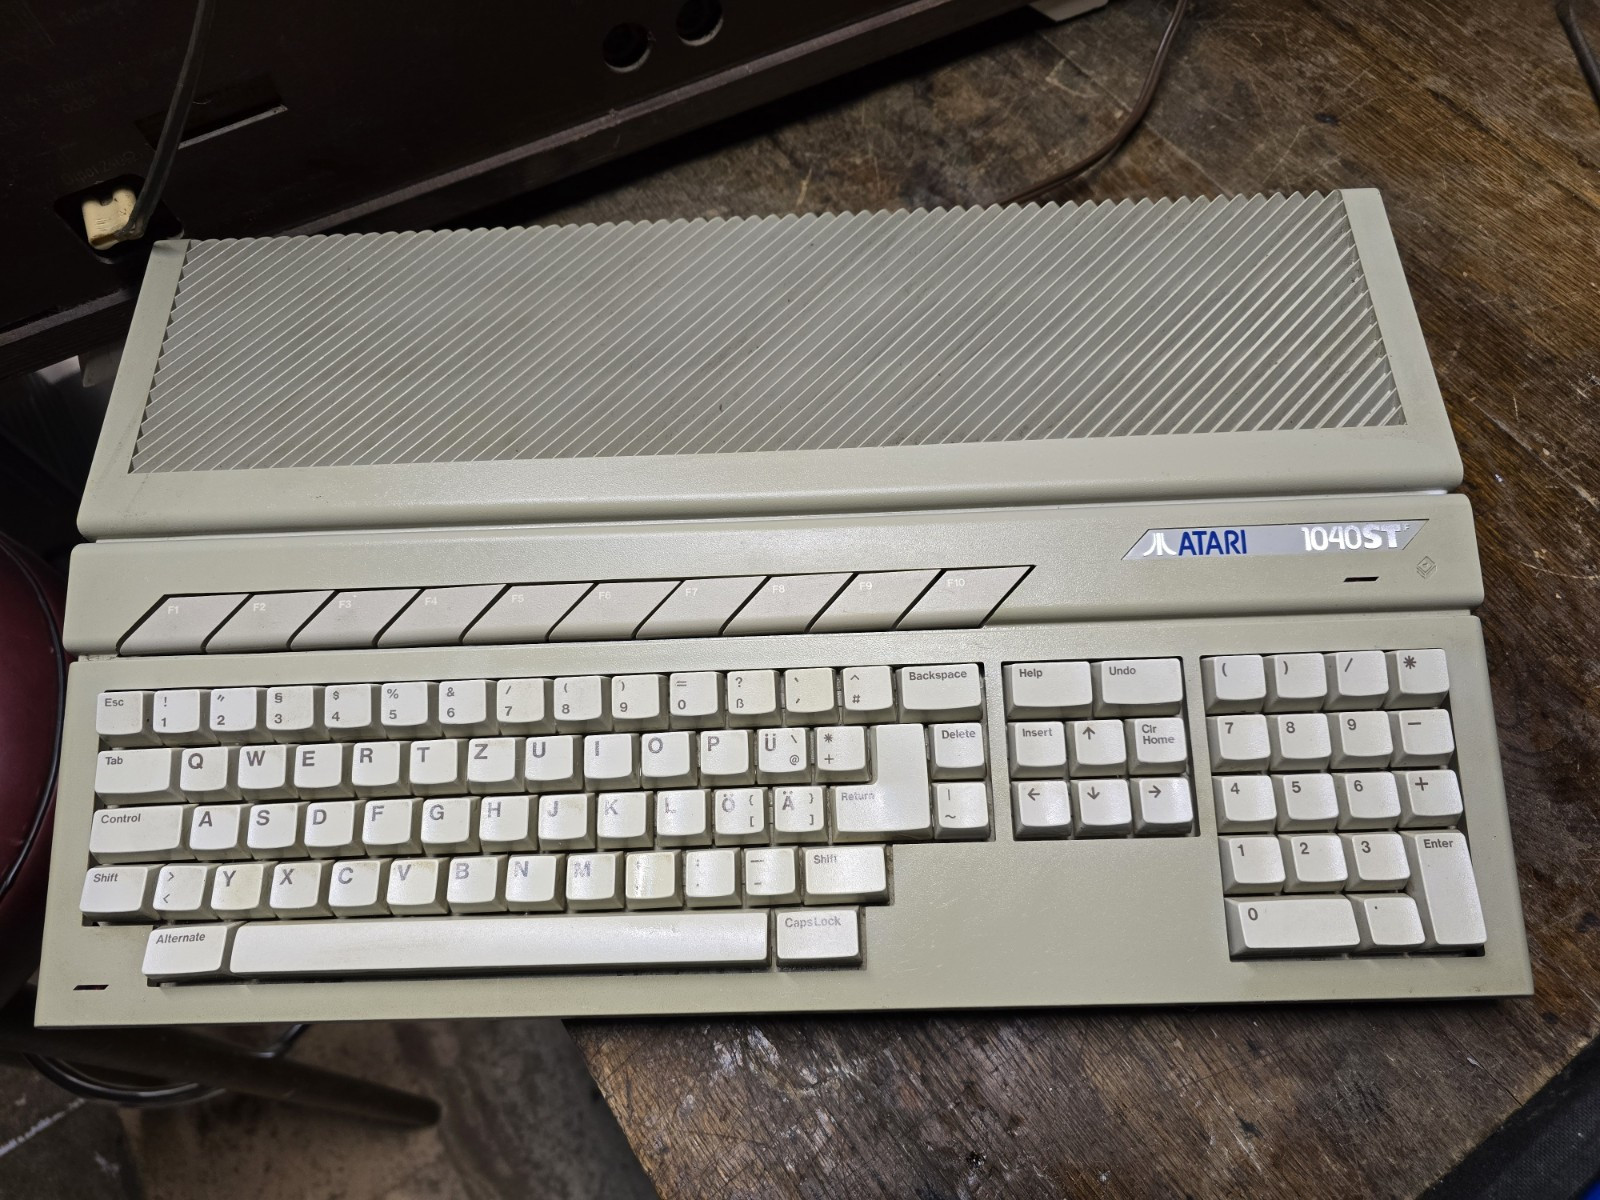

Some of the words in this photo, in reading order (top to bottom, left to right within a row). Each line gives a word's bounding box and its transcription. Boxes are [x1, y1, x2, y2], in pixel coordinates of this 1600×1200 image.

[1178, 529, 1247, 556] ATARI
[772, 584, 785, 594] F8
[859, 581, 872, 591] F9
[947, 578, 965, 588] F10
[511, 594, 525, 603] F5
[598, 591, 612, 600] F6
[685, 588, 698, 597] F7
[253, 602, 266, 612] F2
[338, 600, 352, 609] F3
[424, 597, 438, 606] F4
[167, 605, 179, 615] F1
[1344, 657, 1353, 672] /
[908, 670, 968, 682] Backspace
[1019, 668, 1043, 679] Help
[1109, 666, 1136, 676] Undo
[735, 676, 743, 688] ?
[274, 692, 283, 704] §
[332, 690, 340, 701] $
[386, 688, 399, 700] %
[446, 687, 455, 697] &
[104, 697, 124, 708] Esc
[851, 694, 861, 704] #
[447, 707, 456, 718] 6
[504, 705, 513, 717] 7
[561, 703, 570, 715] 8
[619, 702, 628, 713] 9
[217, 714, 226, 726] 2
[274, 713, 283, 724] 3
[331, 711, 341, 722] 4
[388, 709, 398, 720] 5
[161, 717, 167, 728] 1
[1224, 722, 1234, 734] 7
[1285, 721, 1296, 734] 8
[1346, 718, 1357, 731] 9
[941, 729, 976, 740] Delete
[1022, 727, 1053, 738] Insert
[647, 737, 664, 754] O
[707, 736, 720, 752] P
[764, 733, 777, 751] Ü
[1142, 735, 1175, 745] Home
[359, 747, 374, 764] R
[416, 746, 430, 763] T
[473, 743, 489, 760] Z
[532, 741, 546, 759] U
[105, 756, 124, 766] Tab
[187, 752, 204, 770] Q
[246, 750, 266, 767] W
[301, 750, 316, 767] E
[789, 754, 800, 766] @
[824, 754, 834, 765] +
[1230, 782, 1240, 795] 4
[1291, 781, 1301, 793] 5
[1353, 780, 1364, 792] 6
[1415, 777, 1429, 791] +
[782, 790, 795, 812] Ä
[841, 792, 875, 801] Return
[548, 800, 559, 818] J
[604, 799, 619, 816] K
[721, 793, 736, 813] Ö
[371, 805, 385, 822] F
[429, 804, 445, 821] G
[487, 801, 501, 818] H
[101, 813, 141, 825] Control
[198, 810, 213, 827] A
[255, 809, 271, 826] S
[312, 809, 327, 825] D
[1299, 842, 1310, 855] 2
[1361, 841, 1371, 853] 3
[1423, 838, 1454, 849] Enter
[1238, 844, 1245, 857] 1
[813, 854, 838, 864] Shift
[337, 867, 354, 884] C
[397, 864, 412, 881] V
[455, 863, 470, 880] B
[513, 861, 529, 878] N
[574, 862, 591, 878] M
[93, 873, 119, 883] Shift
[222, 870, 237, 887] Y
[279, 868, 295, 885] X
[1247, 907, 1259, 921] 0
[155, 932, 206, 944] Alternate
